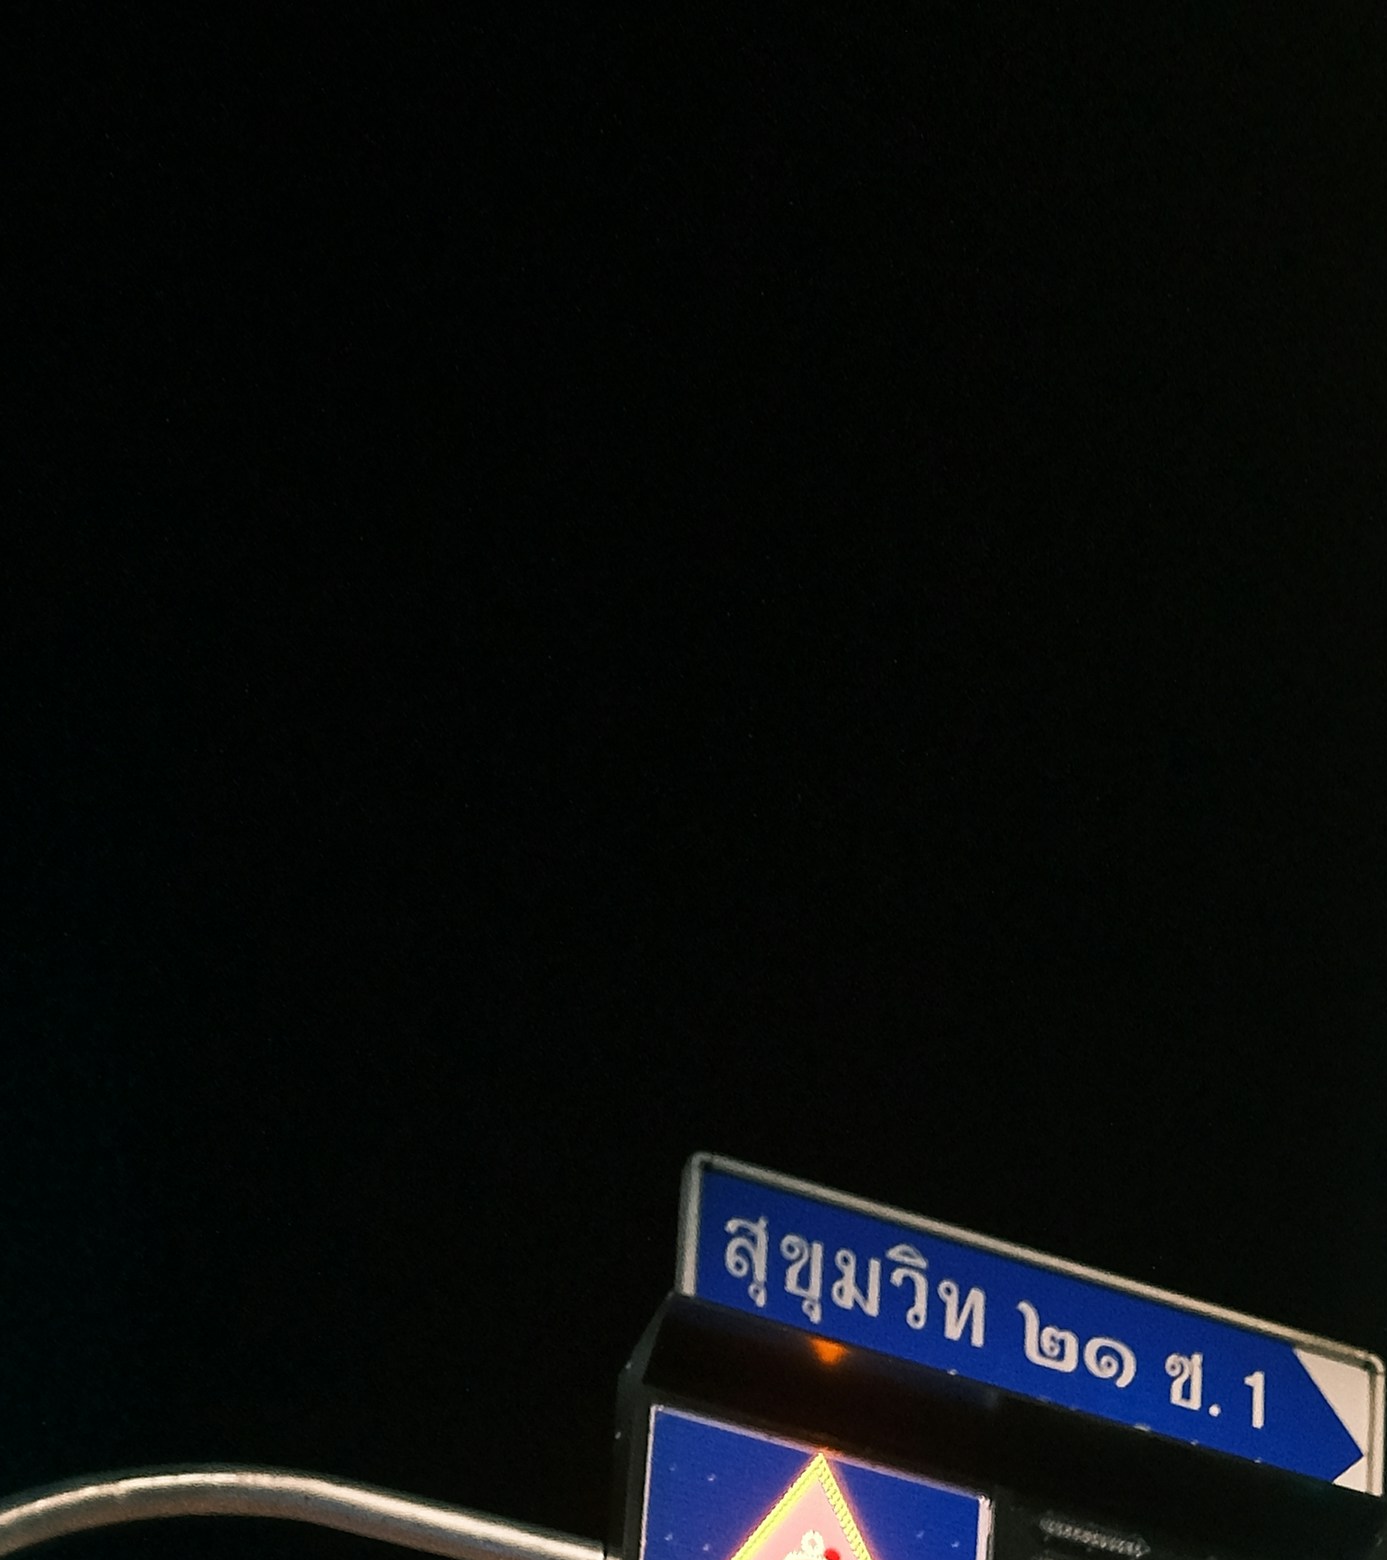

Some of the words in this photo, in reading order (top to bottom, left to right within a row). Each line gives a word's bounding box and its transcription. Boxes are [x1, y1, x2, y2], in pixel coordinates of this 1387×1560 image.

[723, 1216, 987, 1350] สุขุมวิท
[1018, 1302, 1139, 1390] ๒๑
